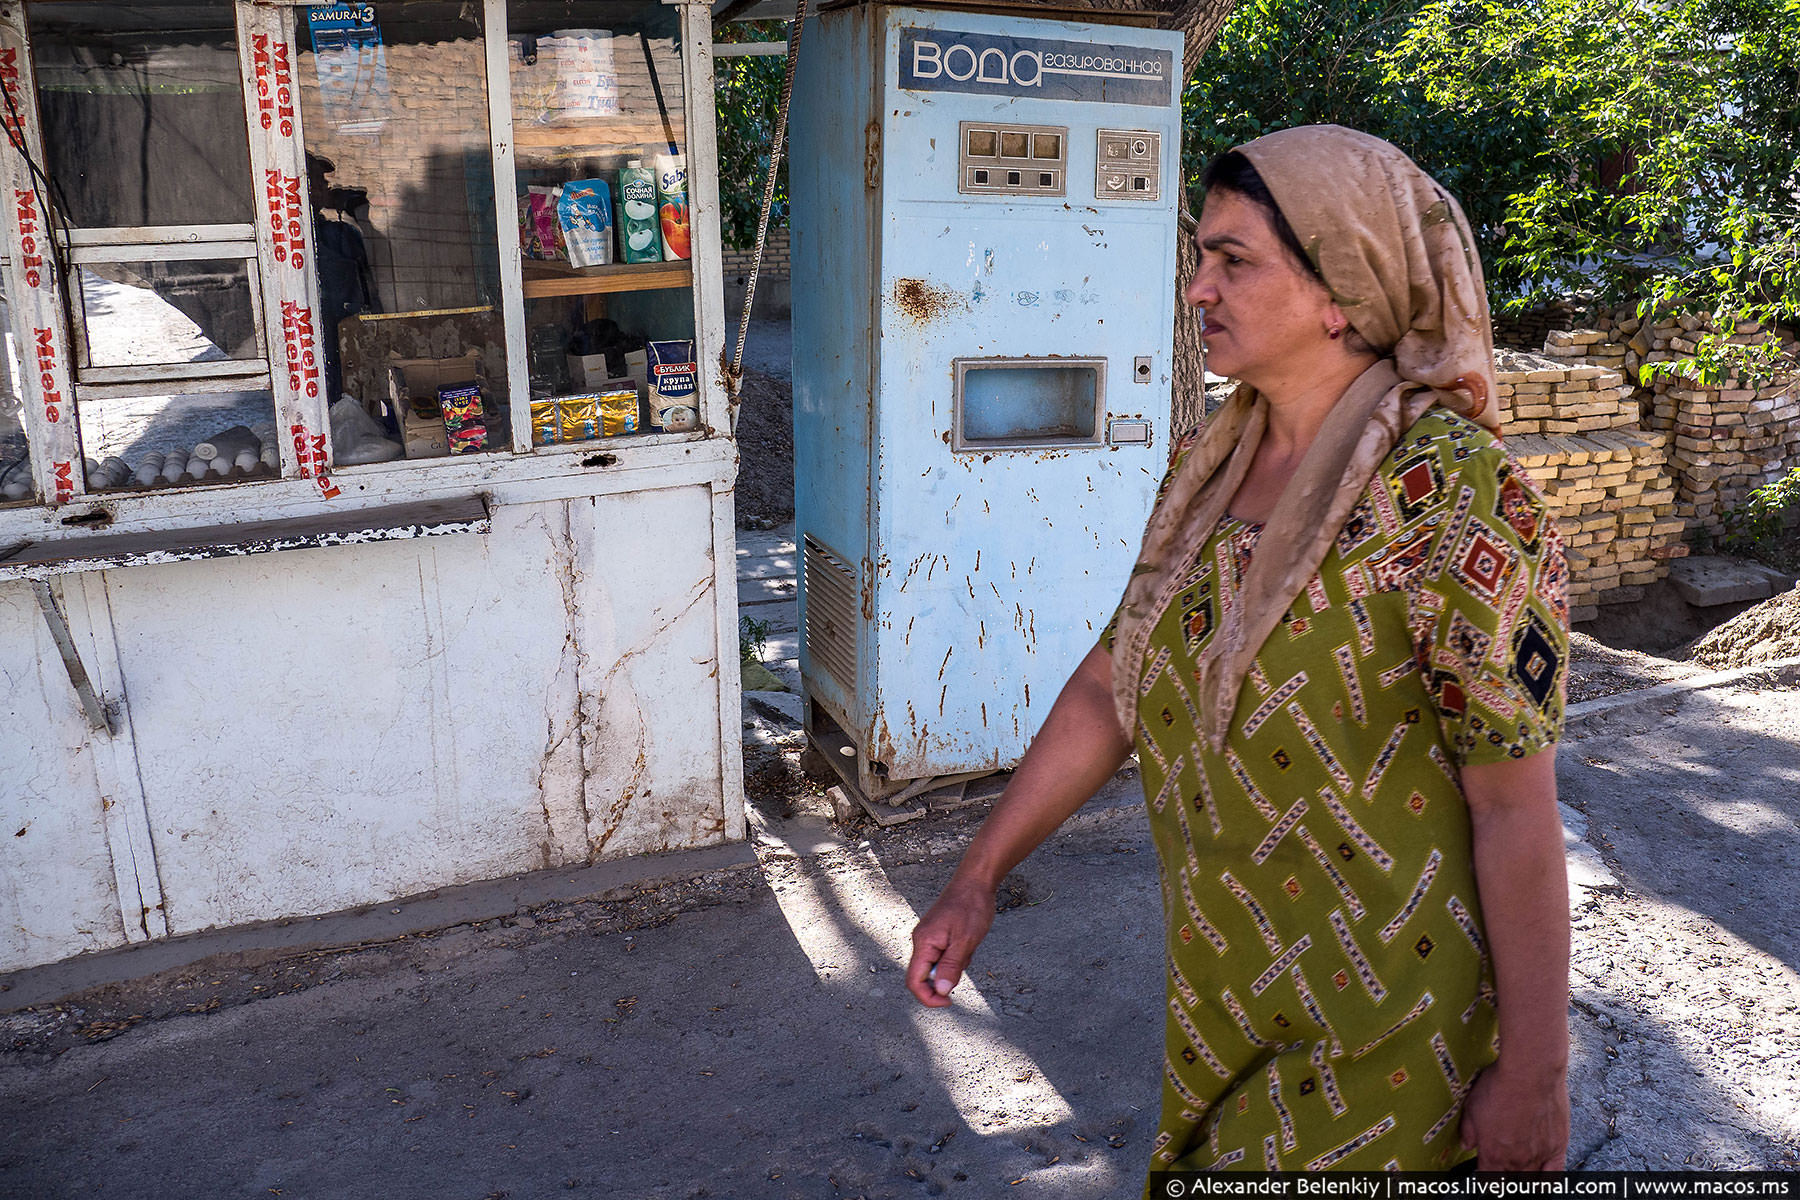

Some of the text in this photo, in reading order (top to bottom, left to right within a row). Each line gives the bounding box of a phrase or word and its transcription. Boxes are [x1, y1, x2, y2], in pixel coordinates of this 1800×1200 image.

[251, 33, 276, 130] Miele
[272, 41, 295, 138] Miele
[1044, 53, 1162, 74] газированная
[15, 189, 43, 288] Miele
[265, 168, 288, 263] Miele
[283, 176, 307, 270] Miele
[34, 327, 62, 424] Miele
[280, 300, 303, 392] Miele
[294, 307, 320, 398] Miele
[660, 365, 691, 373] БУБЛИК
[660, 383, 694, 391] манная
[663, 376, 690, 385] крупа
